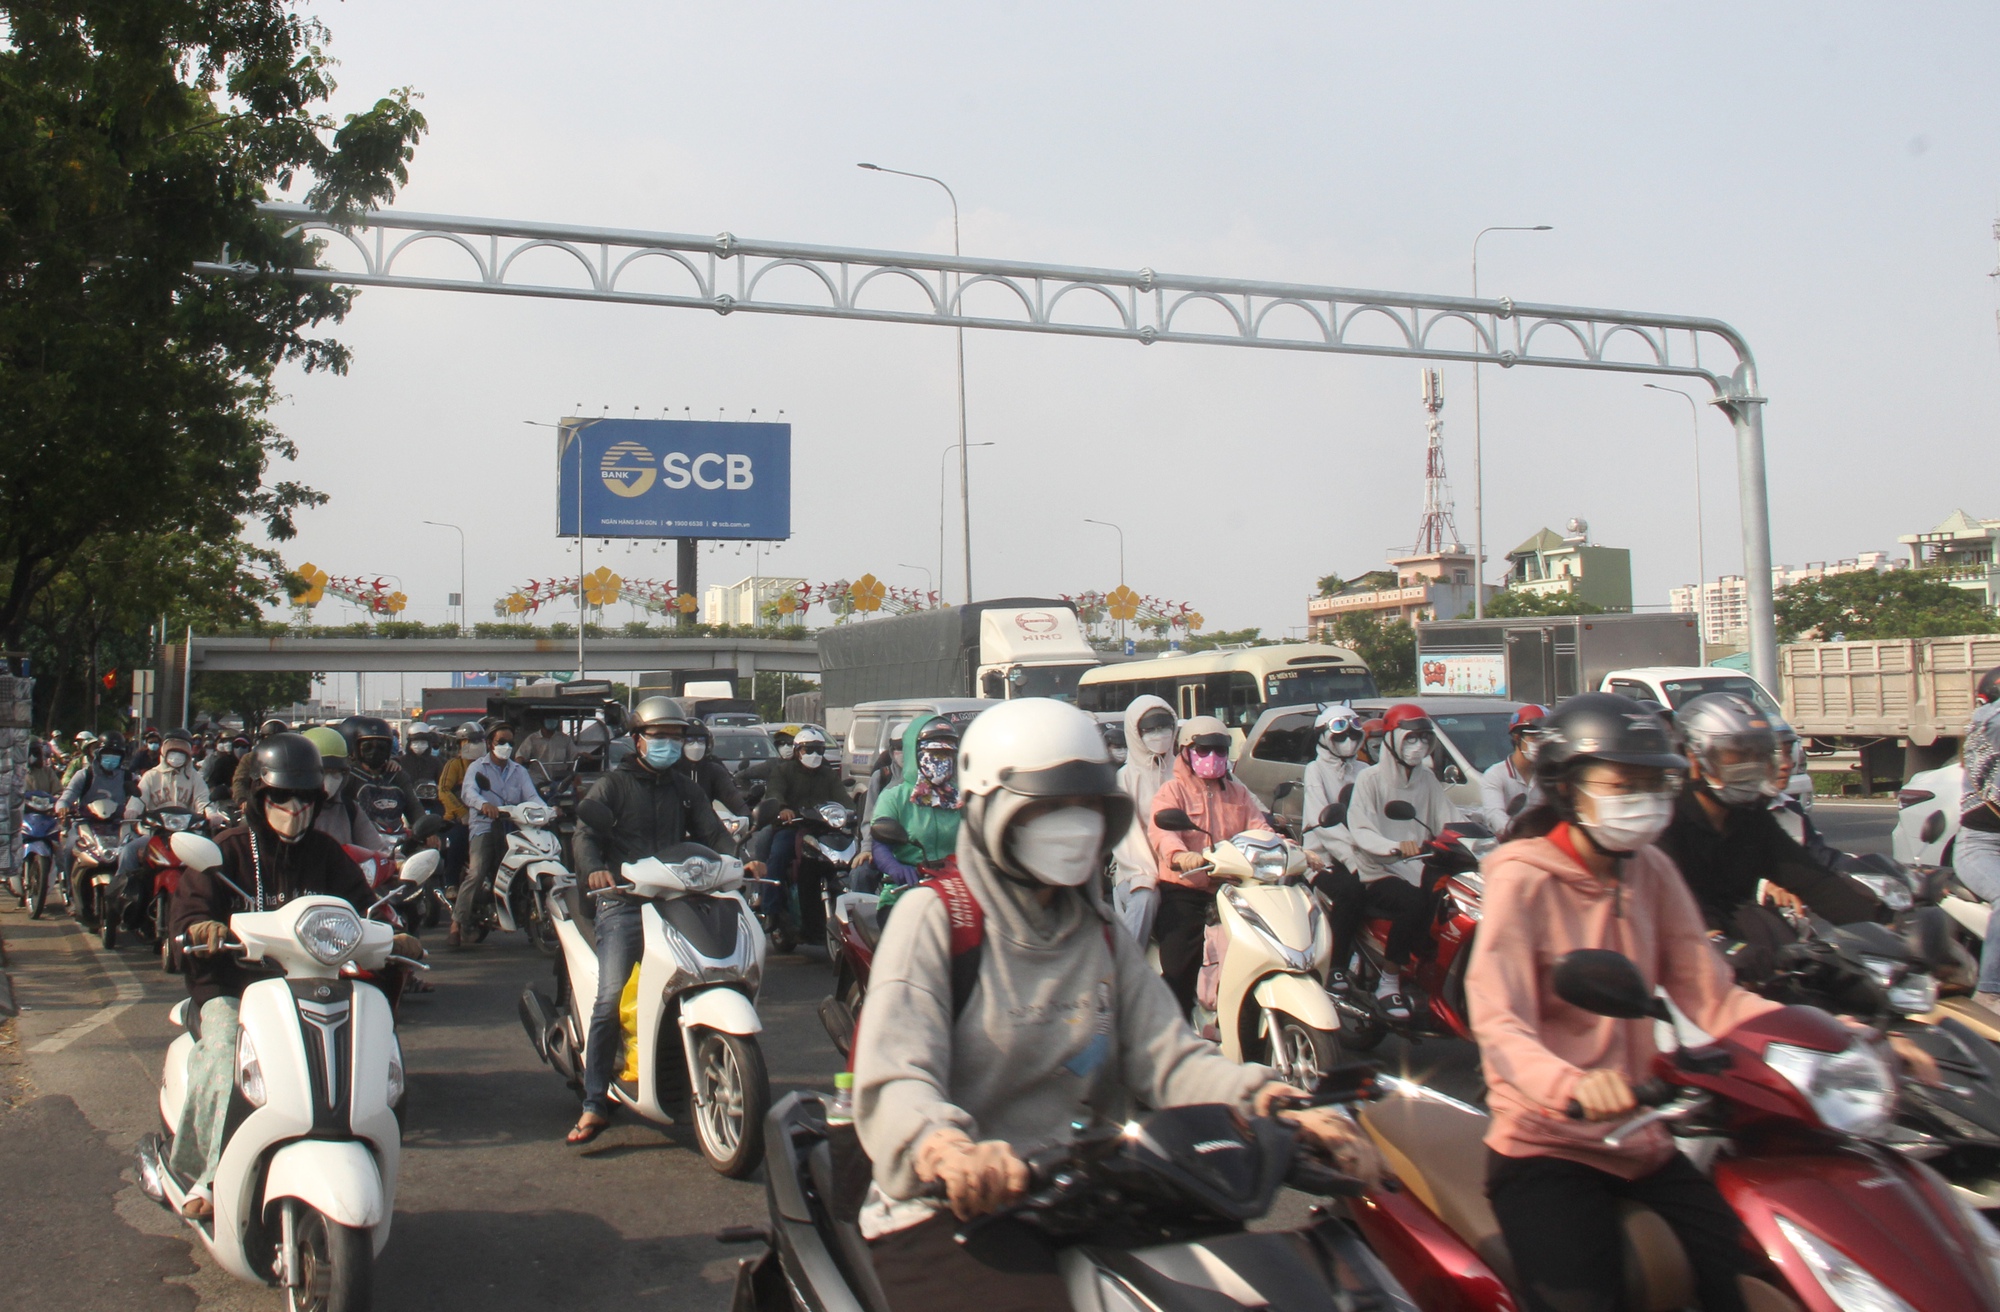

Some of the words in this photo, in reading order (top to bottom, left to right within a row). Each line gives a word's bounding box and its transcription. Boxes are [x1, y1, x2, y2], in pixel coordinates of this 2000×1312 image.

[601, 471, 629, 479] BANK
[663, 452, 754, 490] SCB
[1334, 972, 1343, 981] C
[1391, 995, 1402, 1005] C
